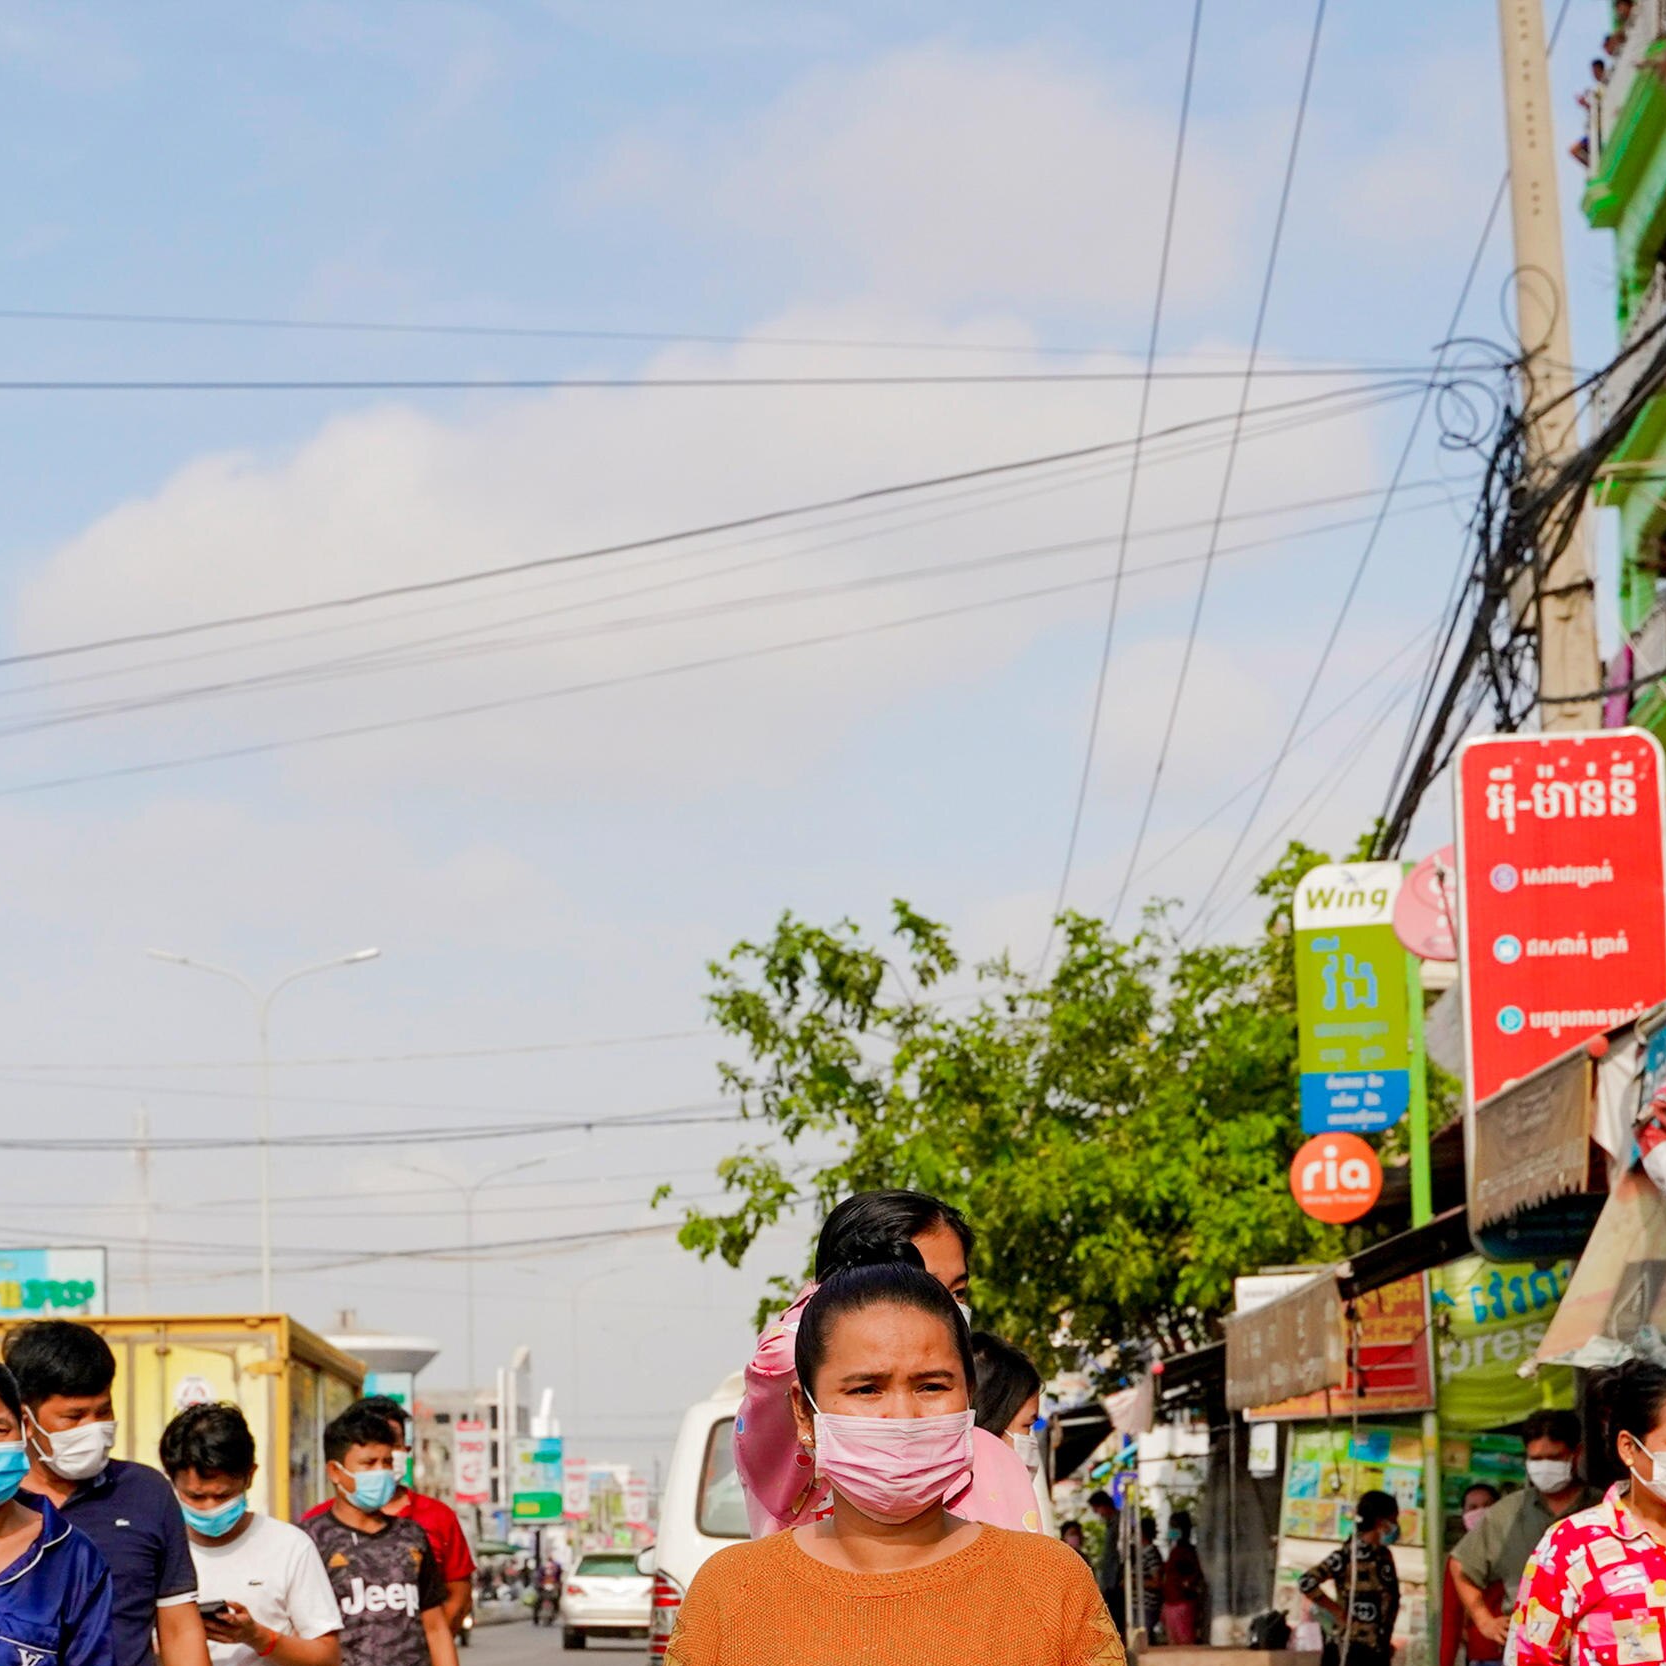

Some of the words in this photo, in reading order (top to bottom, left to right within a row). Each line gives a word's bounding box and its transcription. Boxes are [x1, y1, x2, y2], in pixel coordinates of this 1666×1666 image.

[1306, 887, 1389, 920] Wing
[1301, 1145, 1371, 1191] ria
[340, 1576, 420, 1618] Jeep
